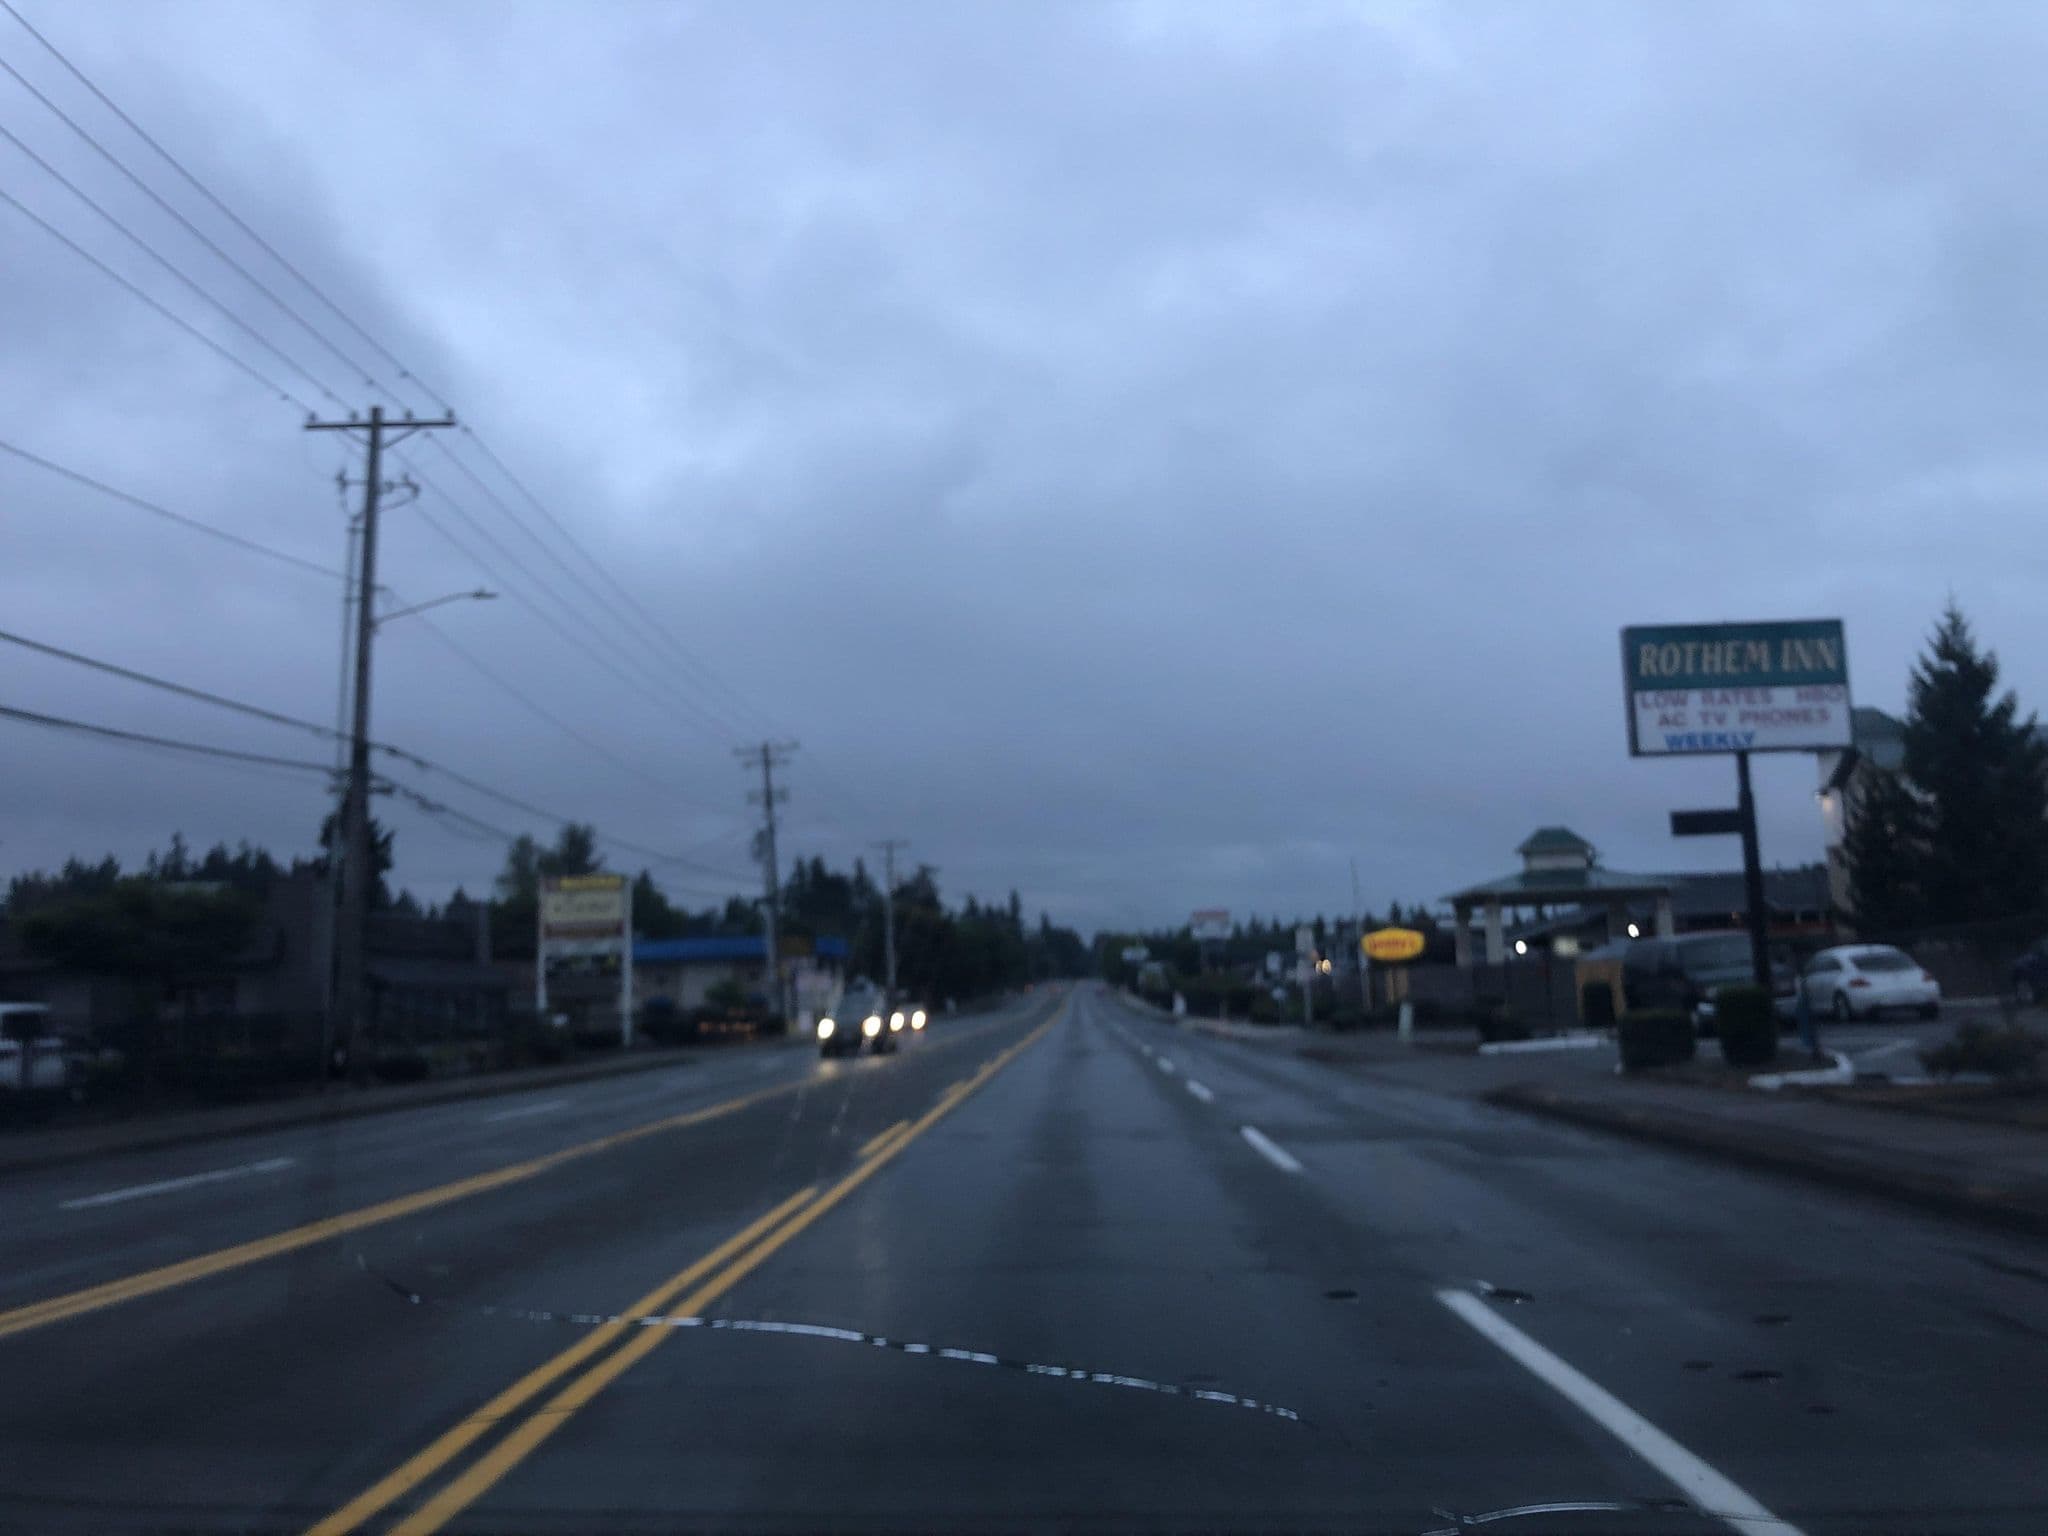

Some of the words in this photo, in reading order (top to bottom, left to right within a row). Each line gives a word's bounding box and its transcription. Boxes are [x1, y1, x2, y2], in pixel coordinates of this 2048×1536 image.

[1640, 641, 1769, 676] ROTHEM
[1782, 637, 1838, 673] INN
[1640, 691, 1689, 709] LOW
[1702, 689, 1773, 704] RATES
[1658, 712, 1687, 727] AC
[1700, 710, 1727, 725] TV
[1666, 732, 1754, 750] WEEKLY
